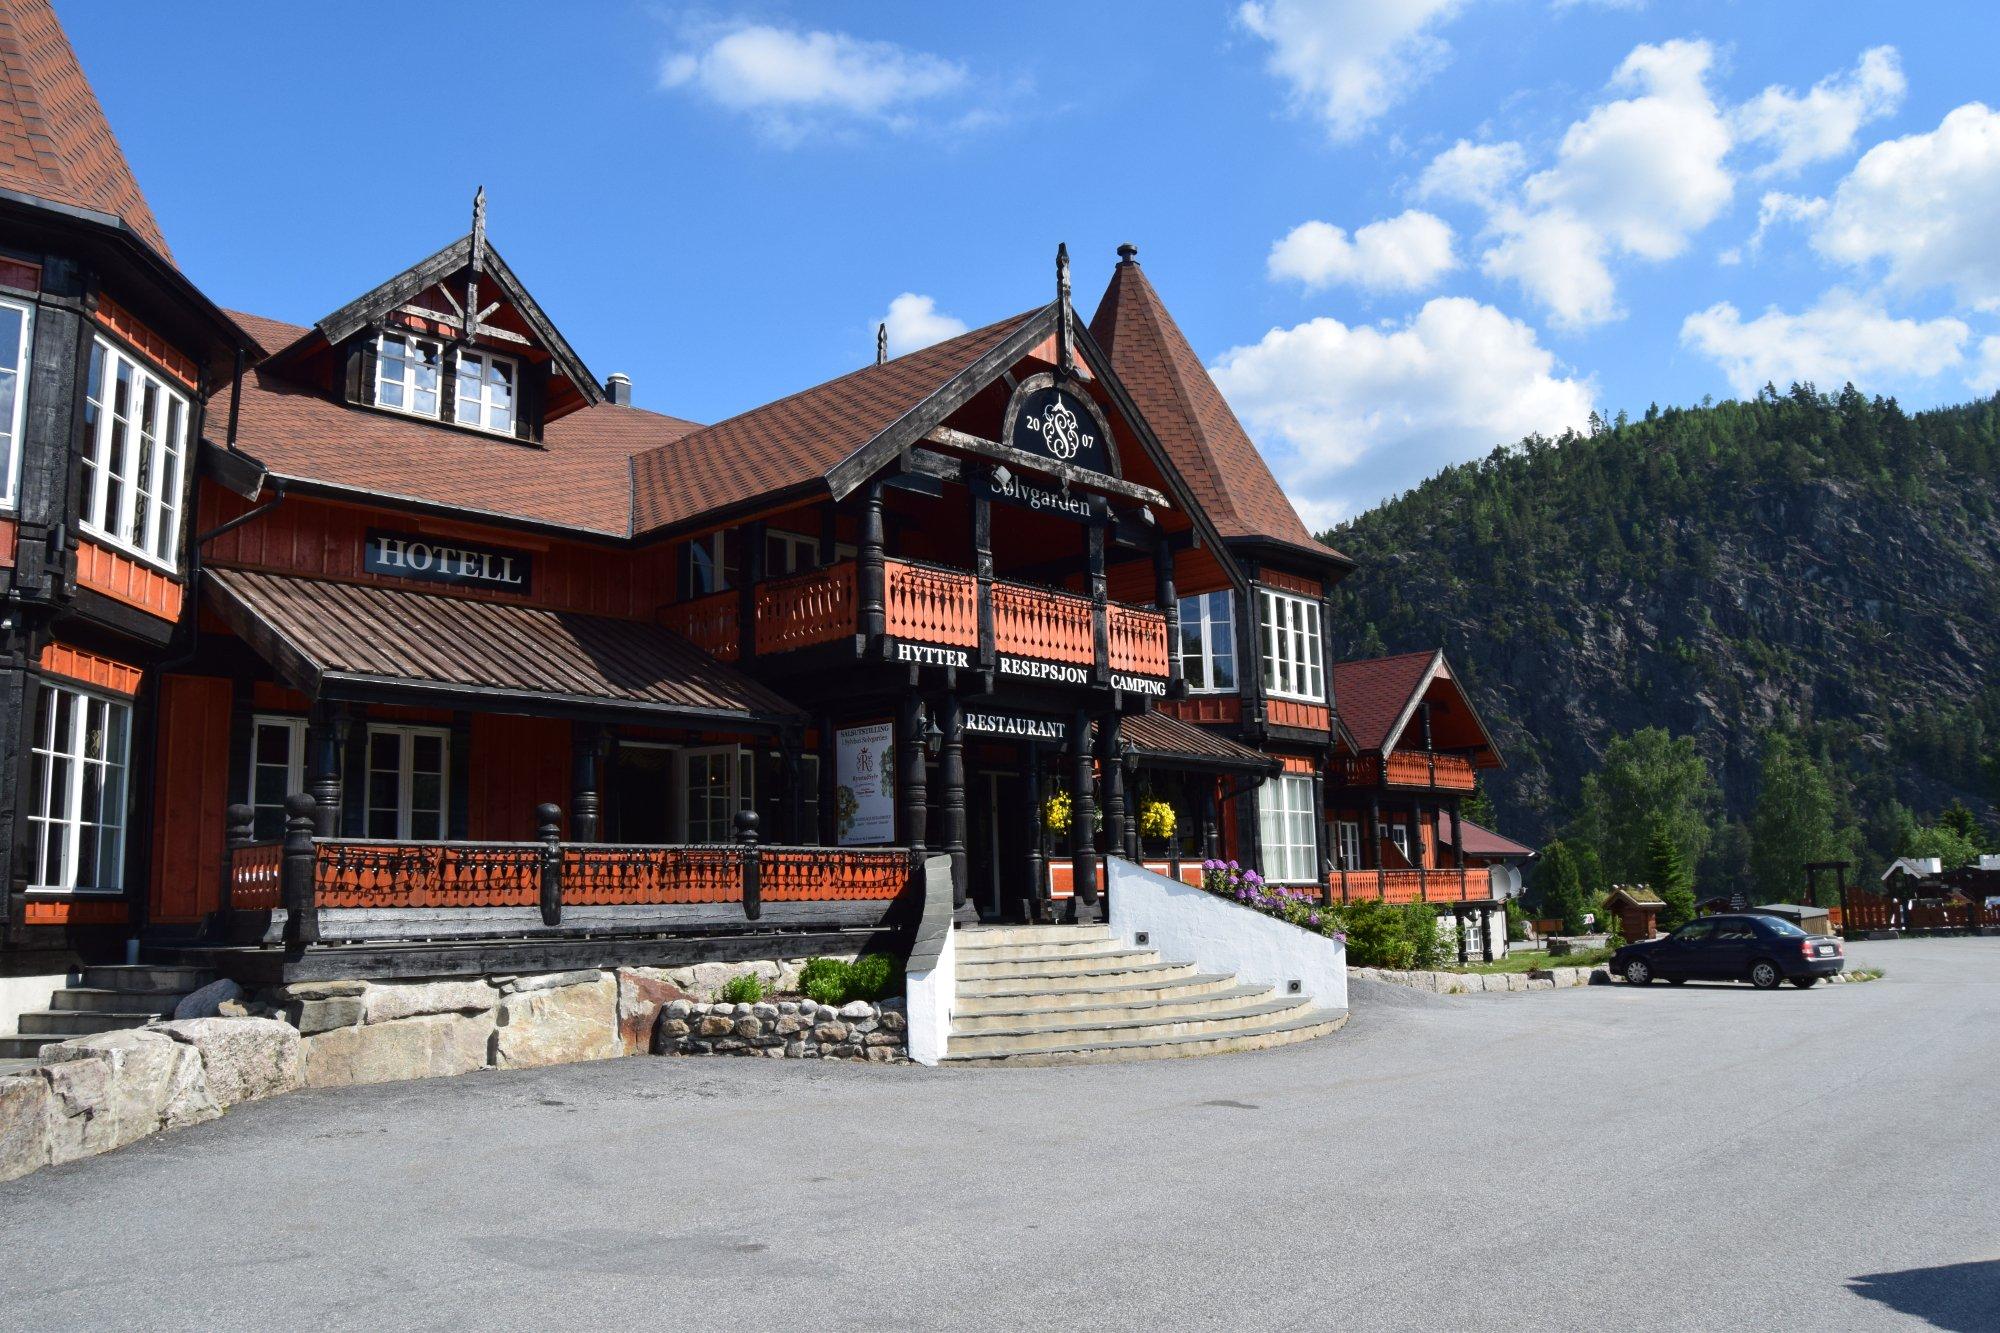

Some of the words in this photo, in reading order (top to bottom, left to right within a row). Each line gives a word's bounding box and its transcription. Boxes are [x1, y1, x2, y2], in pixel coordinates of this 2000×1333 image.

[1026, 415, 1040, 431] 20
[1081, 434, 1094, 449] 07
[376, 537, 522, 584] HOTELL
[898, 643, 969, 668] HYTTER
[1000, 657, 1088, 684] RESEPSJON
[1110, 674, 1167, 696] CAMPING
[966, 713, 1066, 738] RESTAURANT
